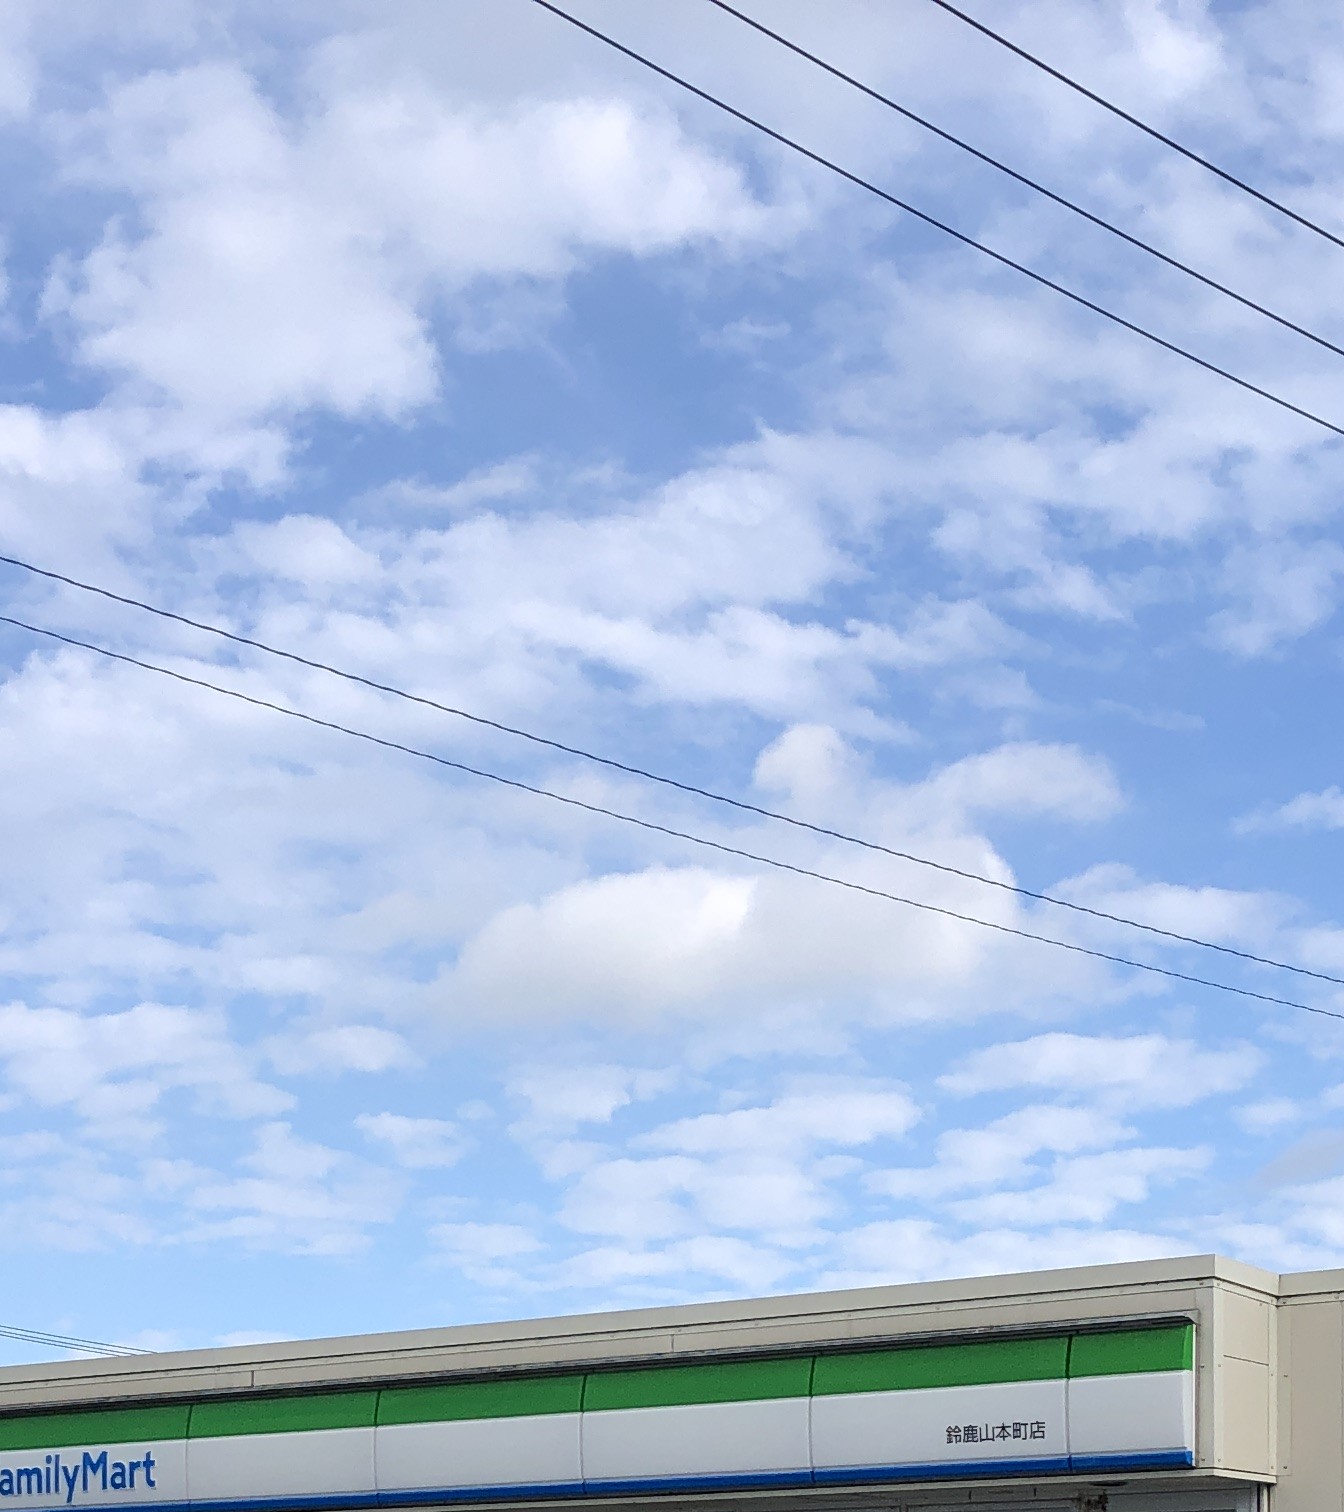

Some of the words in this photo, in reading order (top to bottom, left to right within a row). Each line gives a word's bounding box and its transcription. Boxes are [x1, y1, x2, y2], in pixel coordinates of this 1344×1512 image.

[946, 1420, 1046, 1444] 鈴鹿山本町店
